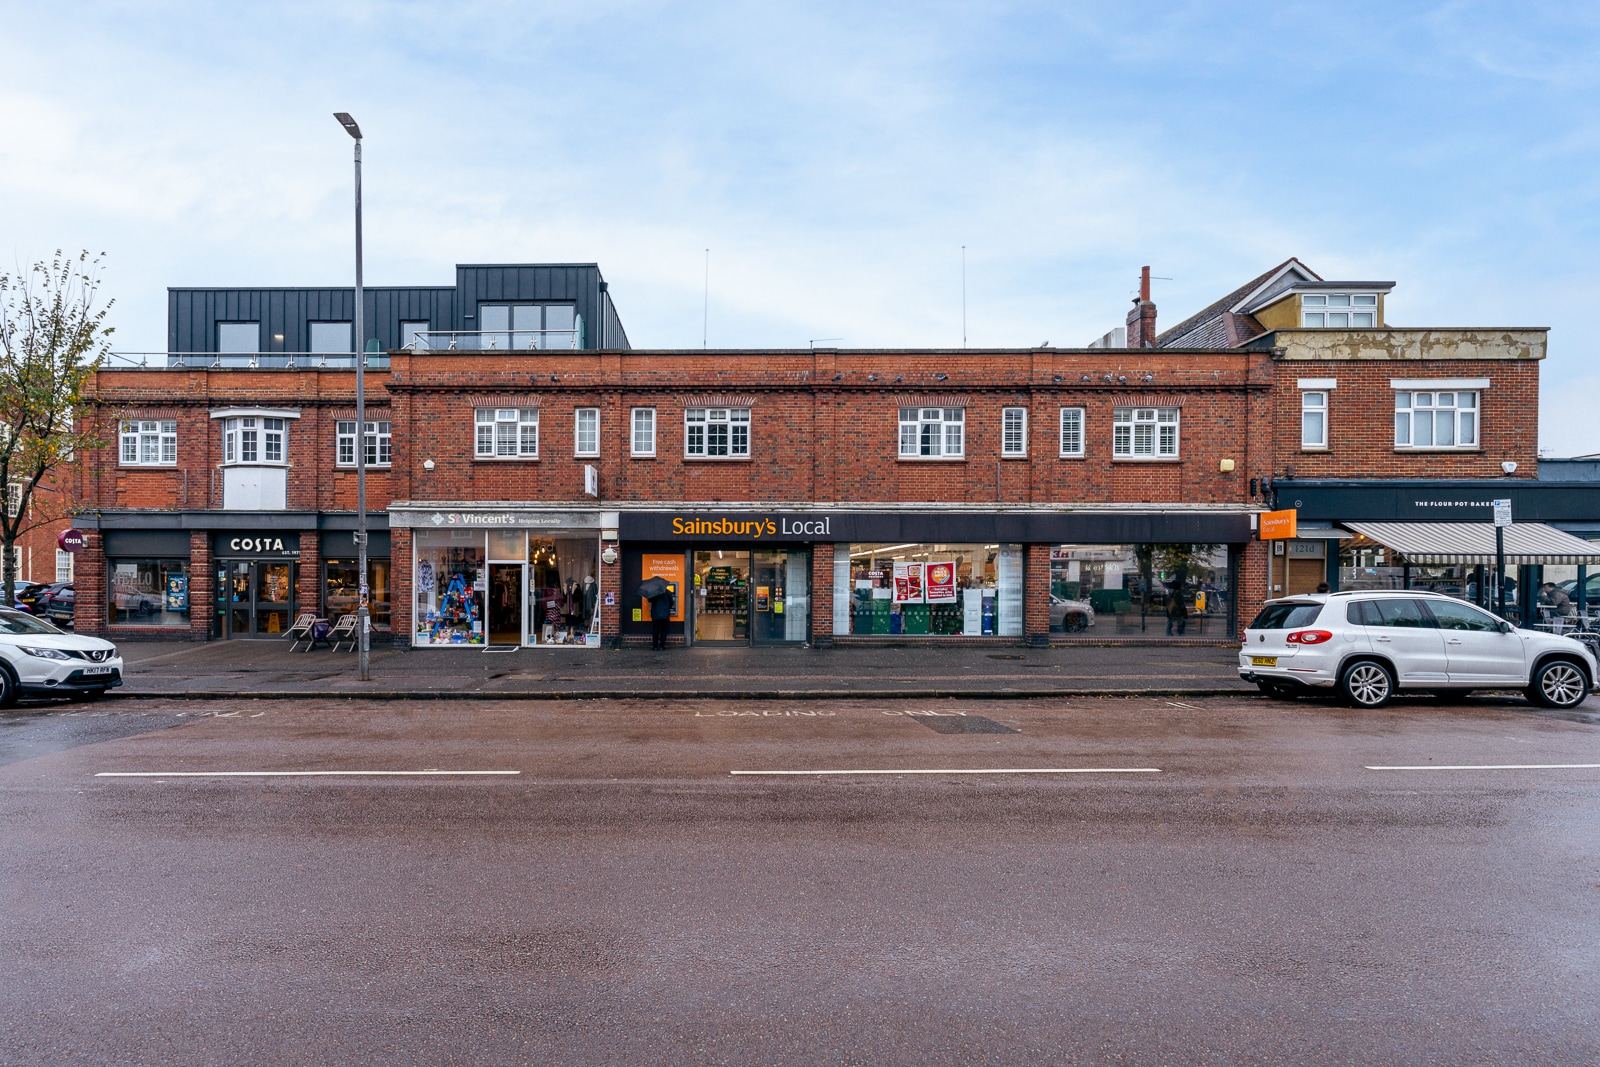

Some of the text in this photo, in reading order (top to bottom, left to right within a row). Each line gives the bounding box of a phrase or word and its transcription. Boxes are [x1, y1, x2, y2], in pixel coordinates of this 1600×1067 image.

[462, 513, 515, 524] Vincent's
[672, 516, 831, 539] Sainsbury's Local
[230, 538, 284, 552] COSTA
[114, 571, 152, 586] HELLO
